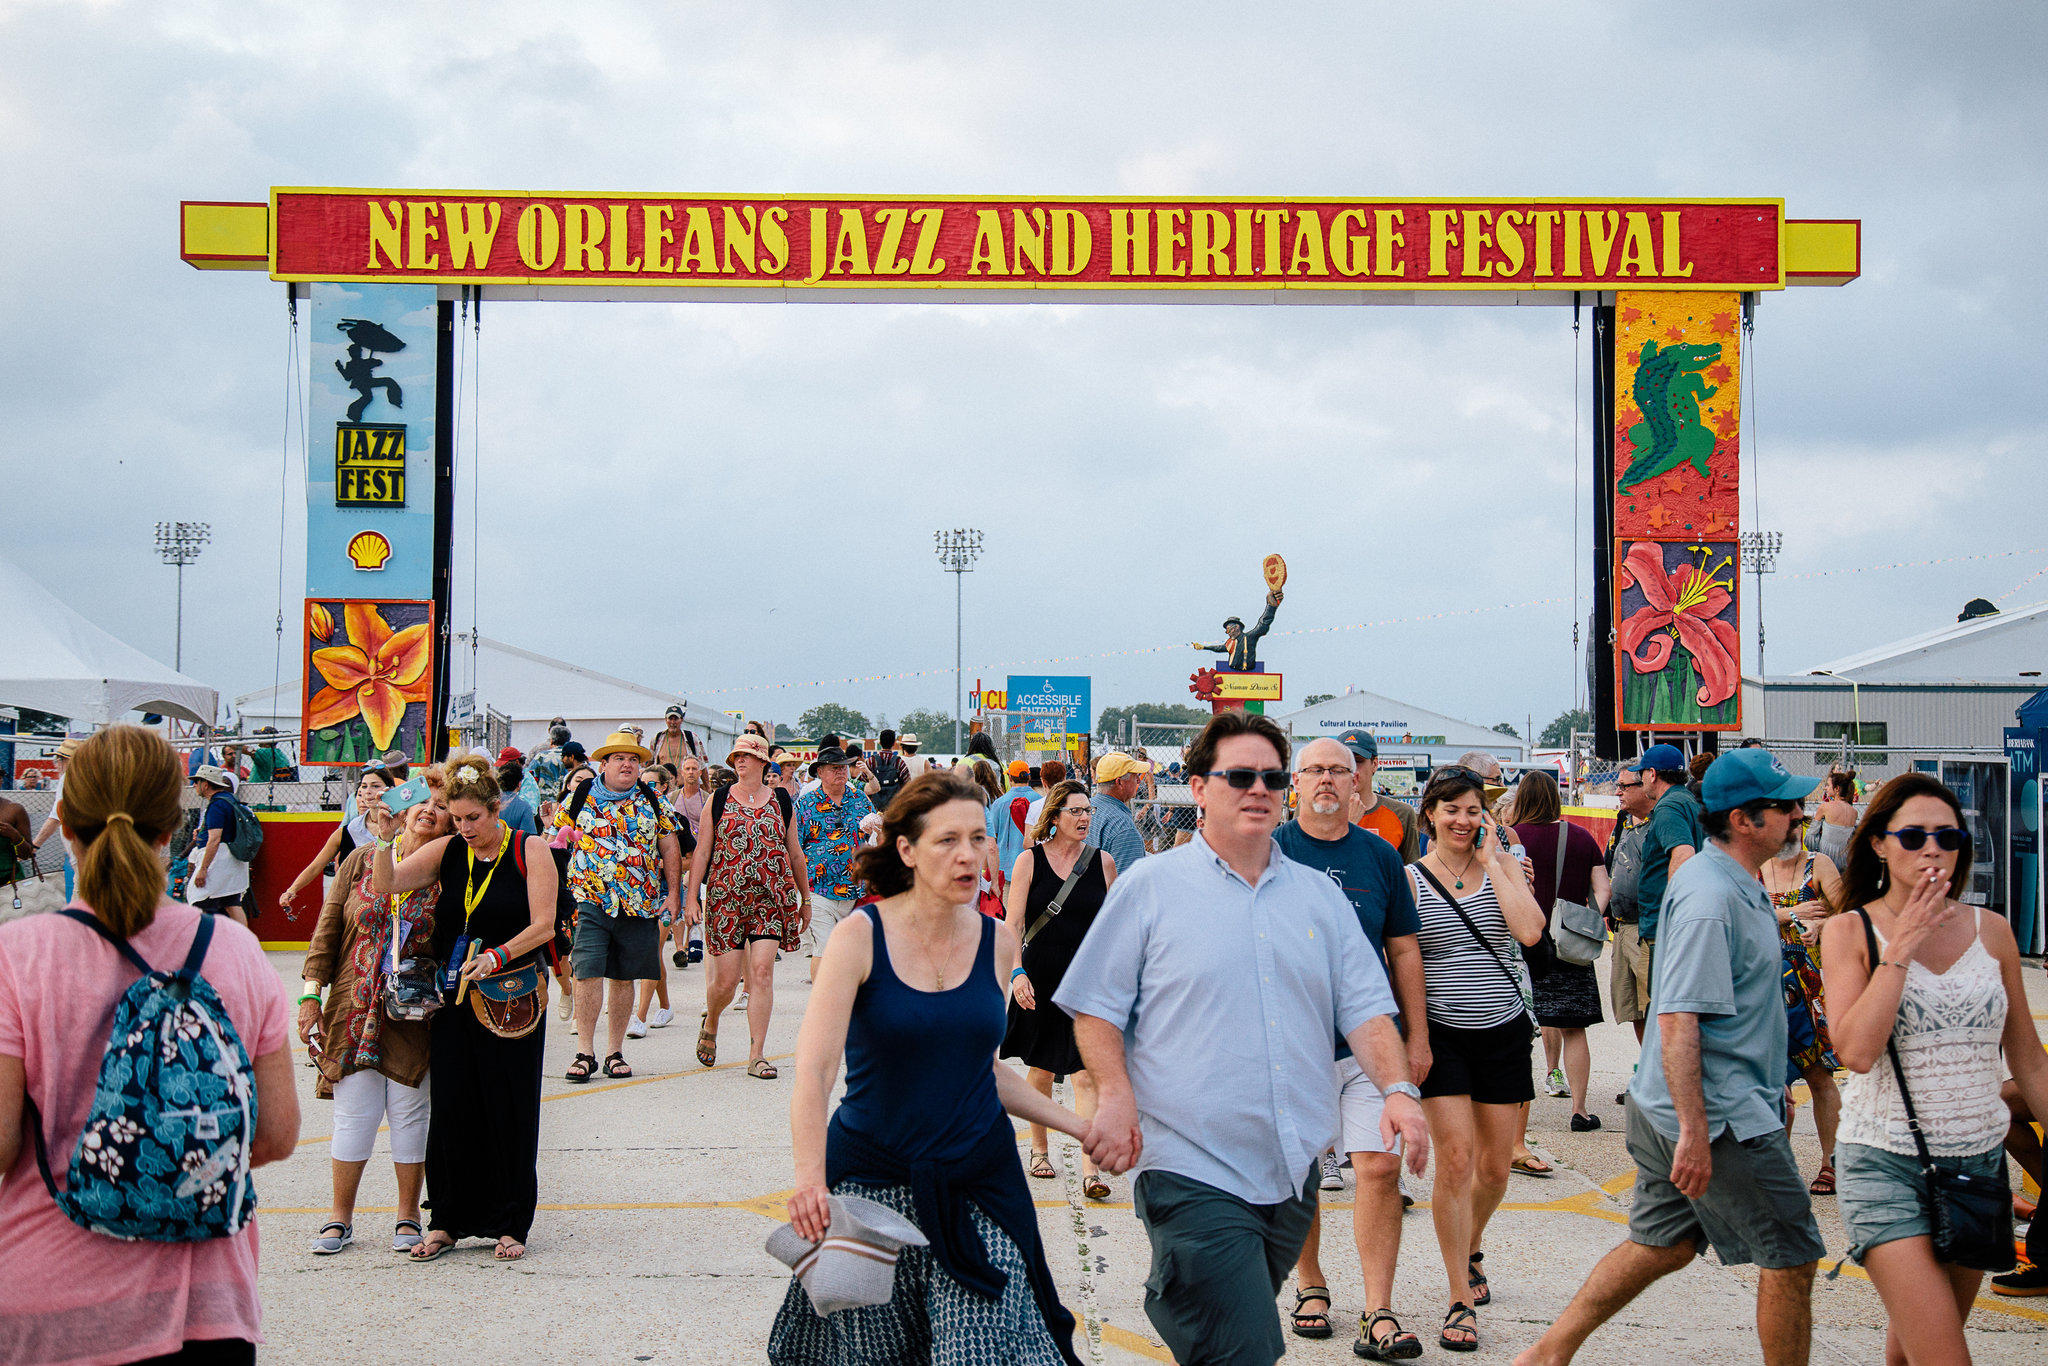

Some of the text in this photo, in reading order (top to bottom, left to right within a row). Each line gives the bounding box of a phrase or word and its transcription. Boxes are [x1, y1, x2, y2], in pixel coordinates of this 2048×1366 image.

[367, 201, 1694, 285] NEW ORLEANS JAZZ AND HERITAGE FESTIVAL
[339, 430, 404, 464] JAZZ
[339, 468, 404, 500] FEST
[1016, 694, 1082, 706] ACCESSIBLE
[1033, 719, 1064, 730] AISLE
[1319, 720, 1346, 728] Cultural
[1381, 720, 1408, 728] Pavilion
[1050, 733, 1076, 744] Croing
[2010, 750, 2033, 773] ATM
